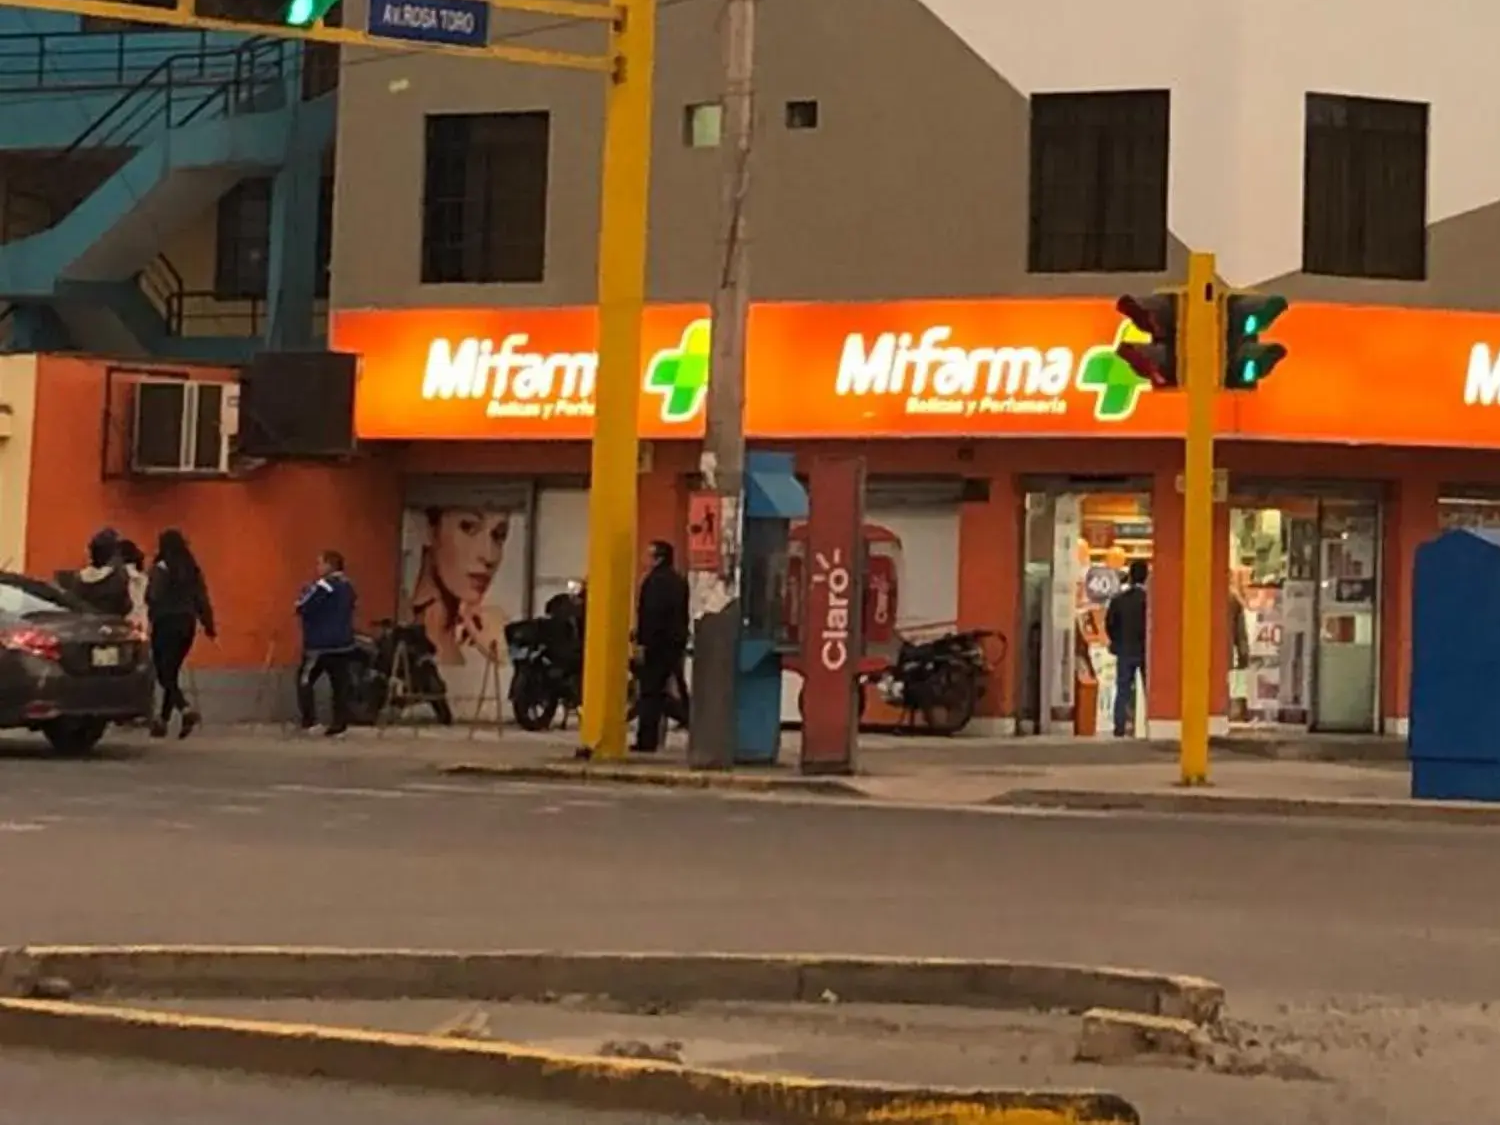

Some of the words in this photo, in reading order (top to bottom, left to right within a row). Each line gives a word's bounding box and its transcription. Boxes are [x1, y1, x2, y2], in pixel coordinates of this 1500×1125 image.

[421, 331, 599, 400] Mifarm
[835, 325, 1074, 398] Mifarma
[822, 567, 849, 671] Claro
